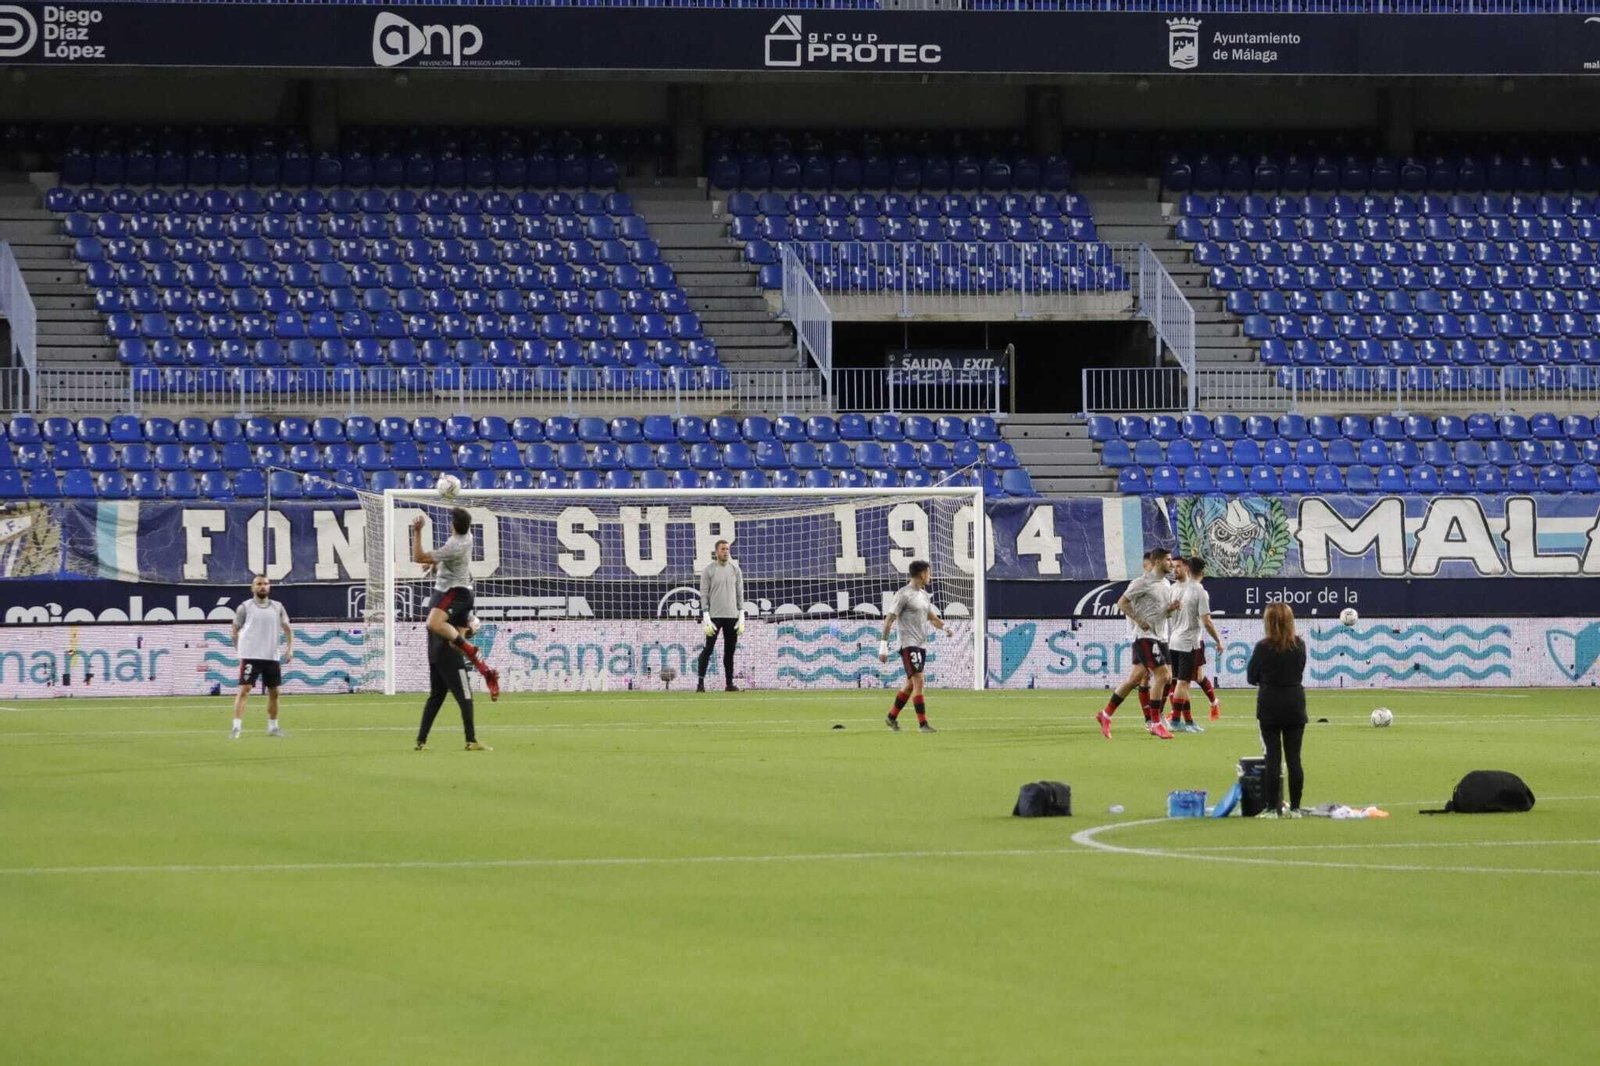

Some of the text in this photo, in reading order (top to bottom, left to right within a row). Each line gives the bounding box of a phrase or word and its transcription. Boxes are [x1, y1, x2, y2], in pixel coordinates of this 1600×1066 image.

[44, 6, 103, 26] Diego
[44, 24, 90, 40] Díaz
[808, 32, 878, 44] group
[1212, 27, 1301, 46] Ayuntamiento
[44, 41, 106, 60] López
[807, 43, 942, 63] PROTEC
[1212, 48, 1278, 63] de Málaga
[902, 357, 995, 371] SALIDA EXIT
[182, 502, 1064, 583] FONDO SUR 1904
[1293, 496, 1600, 578] MAL
[1245, 586, 1359, 604] El sabor de la
[244, 663, 253, 675] 3
